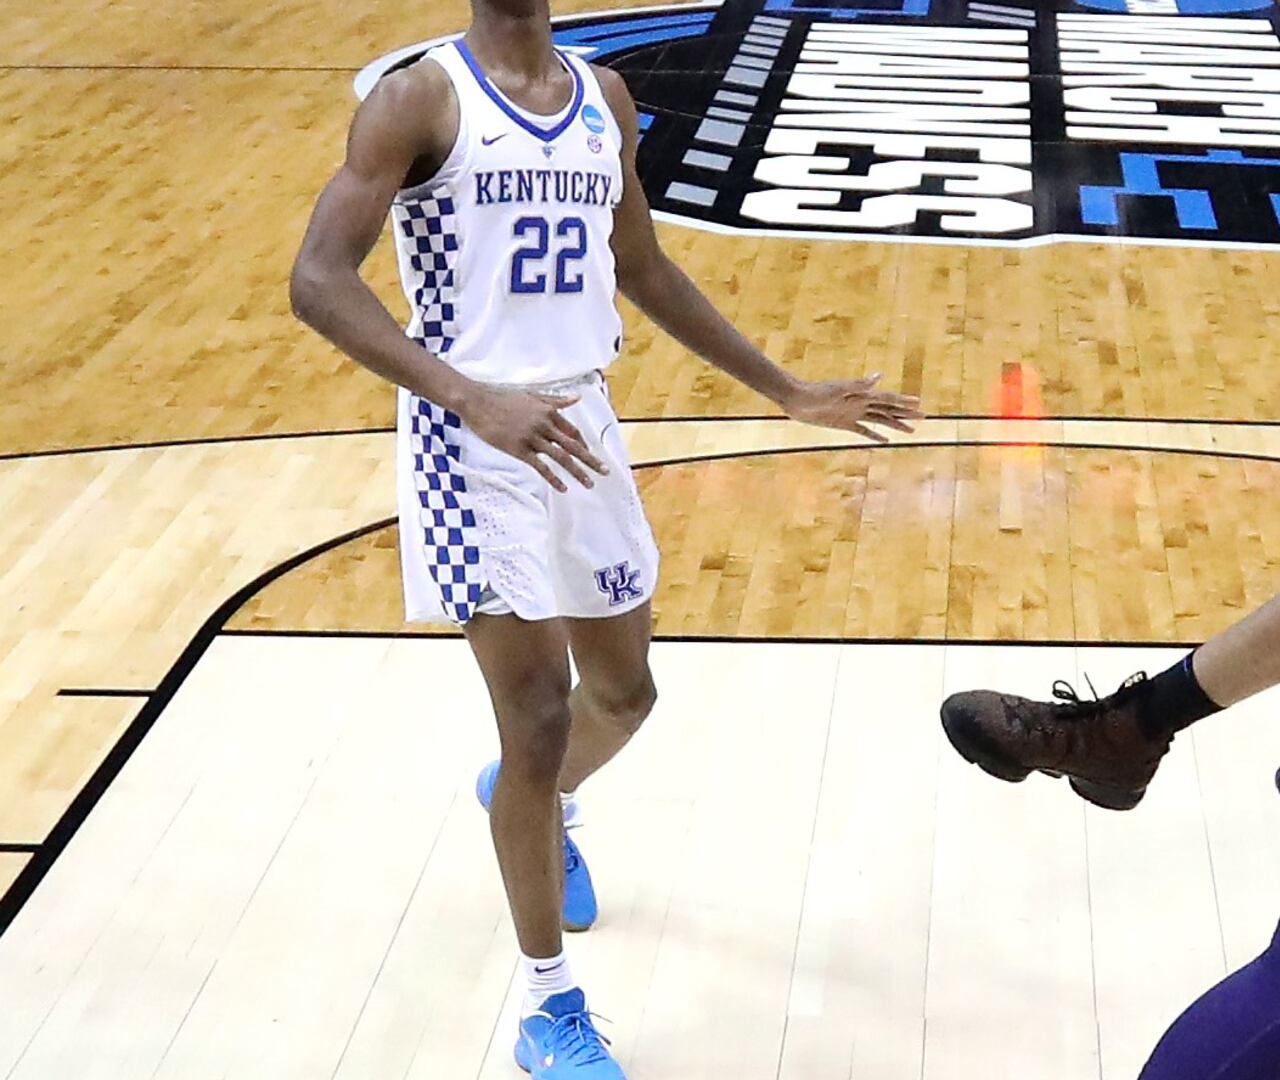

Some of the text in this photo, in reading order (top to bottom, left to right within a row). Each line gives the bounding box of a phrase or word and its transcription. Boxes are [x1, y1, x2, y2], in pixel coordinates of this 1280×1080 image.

[739, 22, 1034, 233] MADNESS
[475, 169, 612, 206] KENTUCKY
[510, 216, 588, 294] 22
[594, 560, 644, 607] UK
